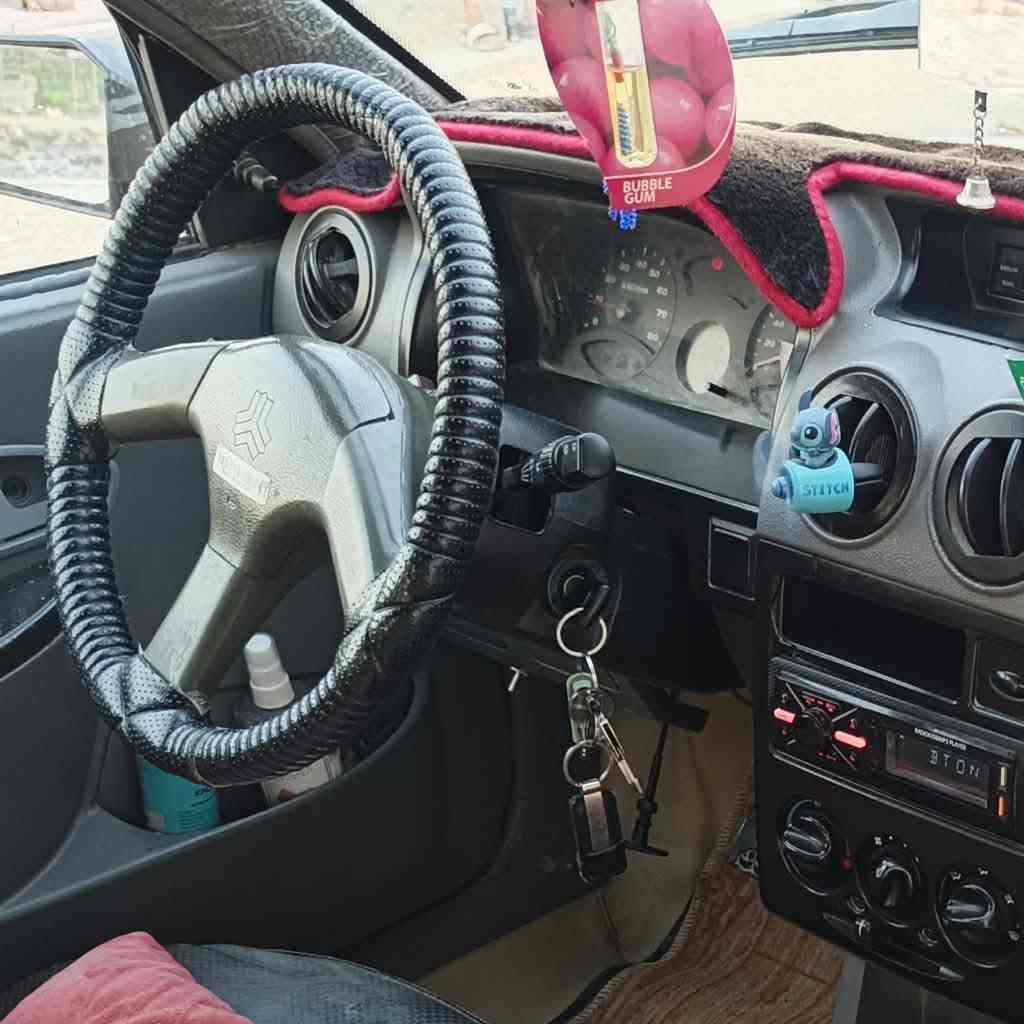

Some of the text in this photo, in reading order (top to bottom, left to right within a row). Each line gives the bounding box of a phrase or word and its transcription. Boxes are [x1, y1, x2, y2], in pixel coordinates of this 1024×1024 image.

[623, 177, 672, 193] BUBBLE
[624, 191, 656, 204] GUM
[802, 481, 849, 497] STITCH
